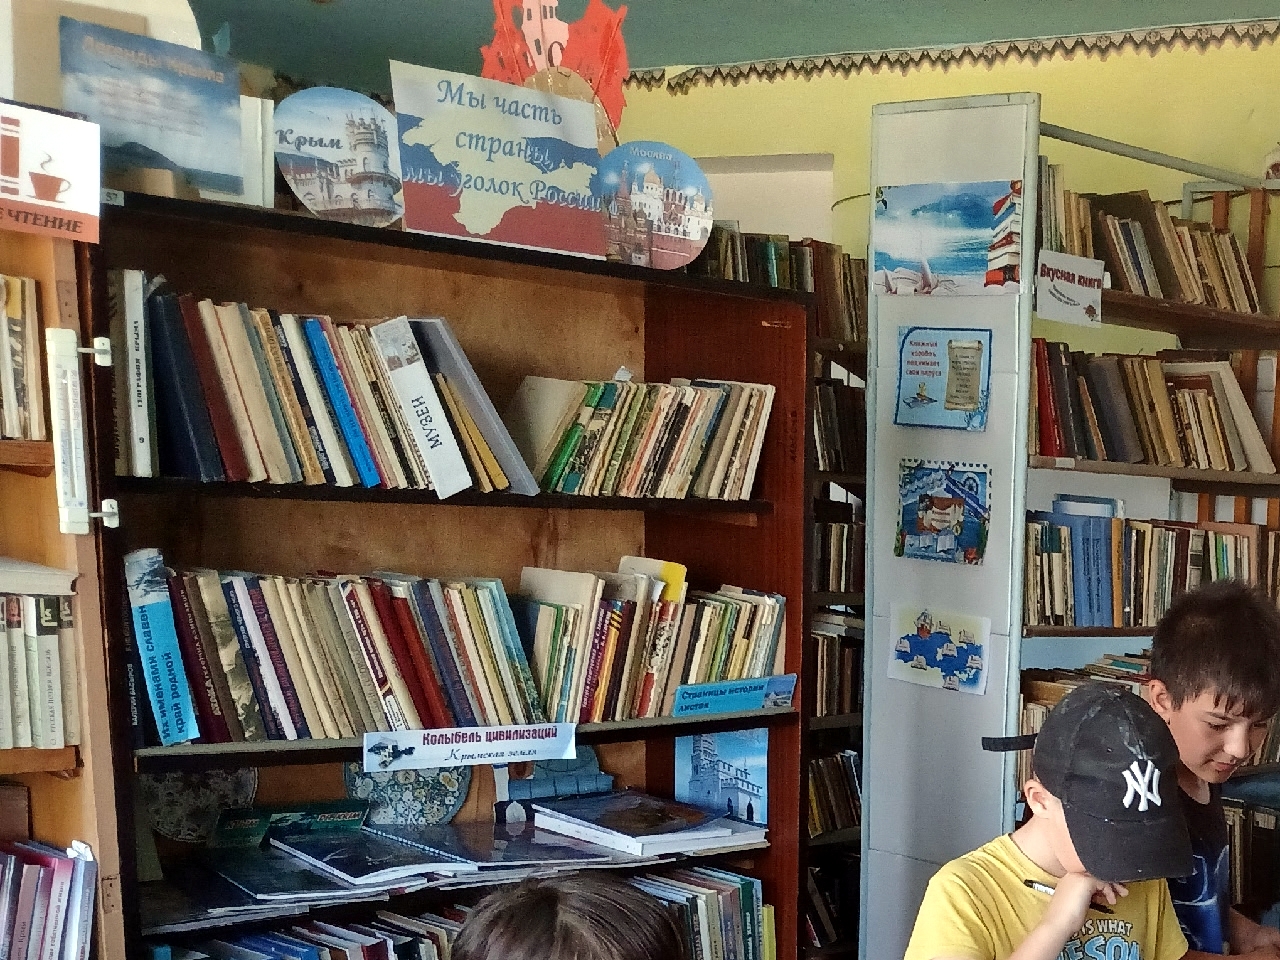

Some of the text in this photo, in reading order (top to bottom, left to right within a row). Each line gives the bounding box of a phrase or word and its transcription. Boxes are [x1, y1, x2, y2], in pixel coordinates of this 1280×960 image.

[437, 80, 563, 126] Мы часть
[276, 128, 344, 150] Крым
[8, 208, 84, 235] ЧТЕНИЕ
[1040, 263, 1076, 286] Вкусная
[422, 725, 558, 746] Колыбель цивилизаций
[1122, 759, 1162, 812] NY
[1095, 919, 1134, 937] WHAT
